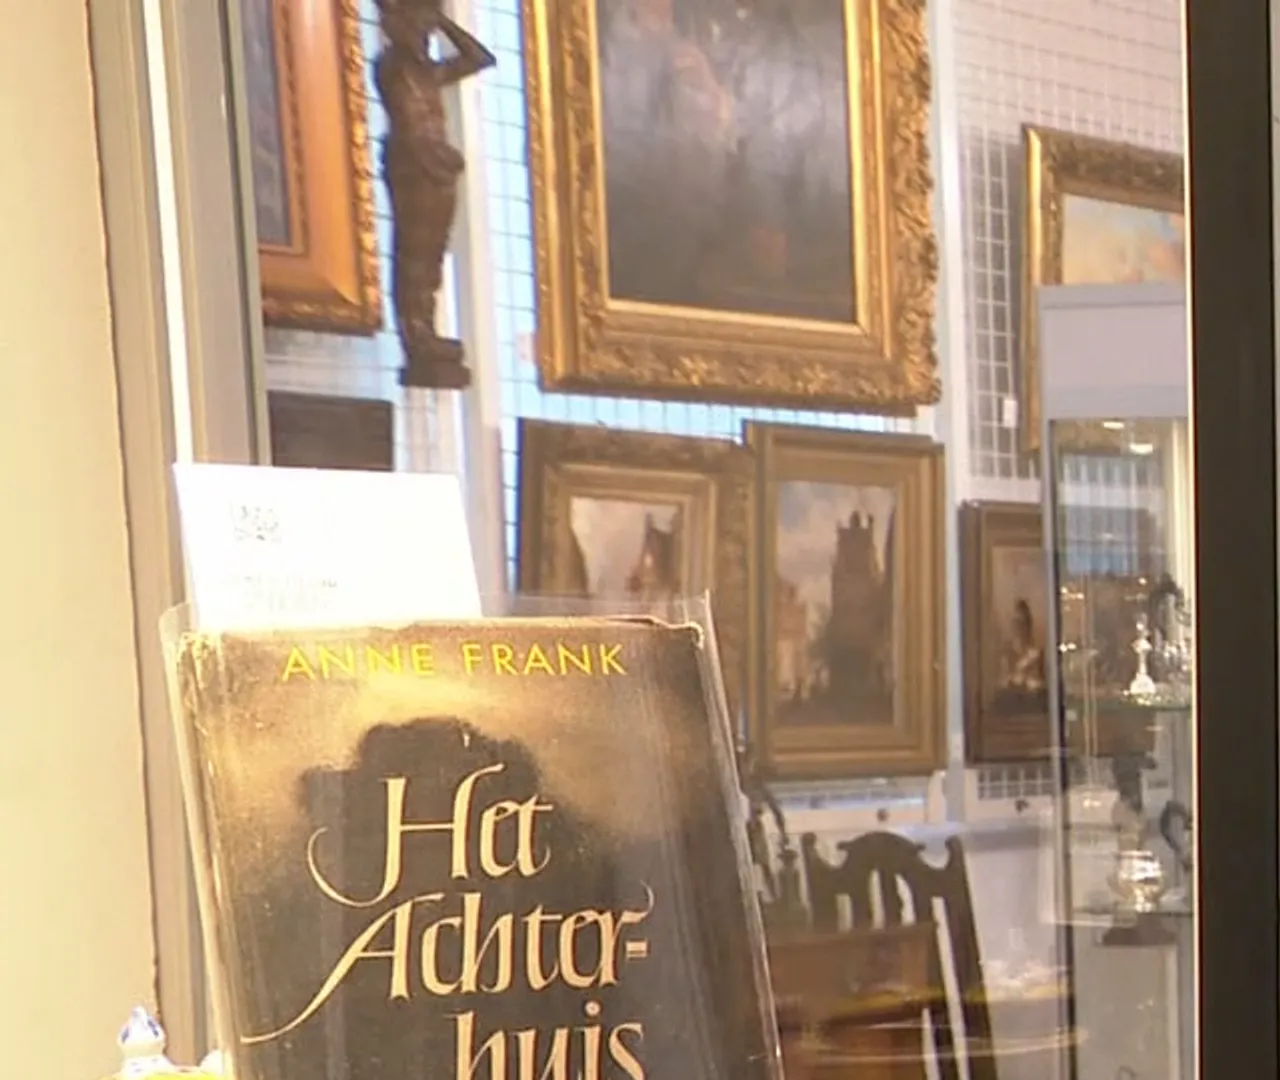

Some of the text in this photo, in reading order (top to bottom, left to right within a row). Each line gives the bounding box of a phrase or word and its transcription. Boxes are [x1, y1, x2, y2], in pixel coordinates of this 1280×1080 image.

[282, 642, 628, 682] ANNE FRANK
[307, 763, 554, 908] Het
